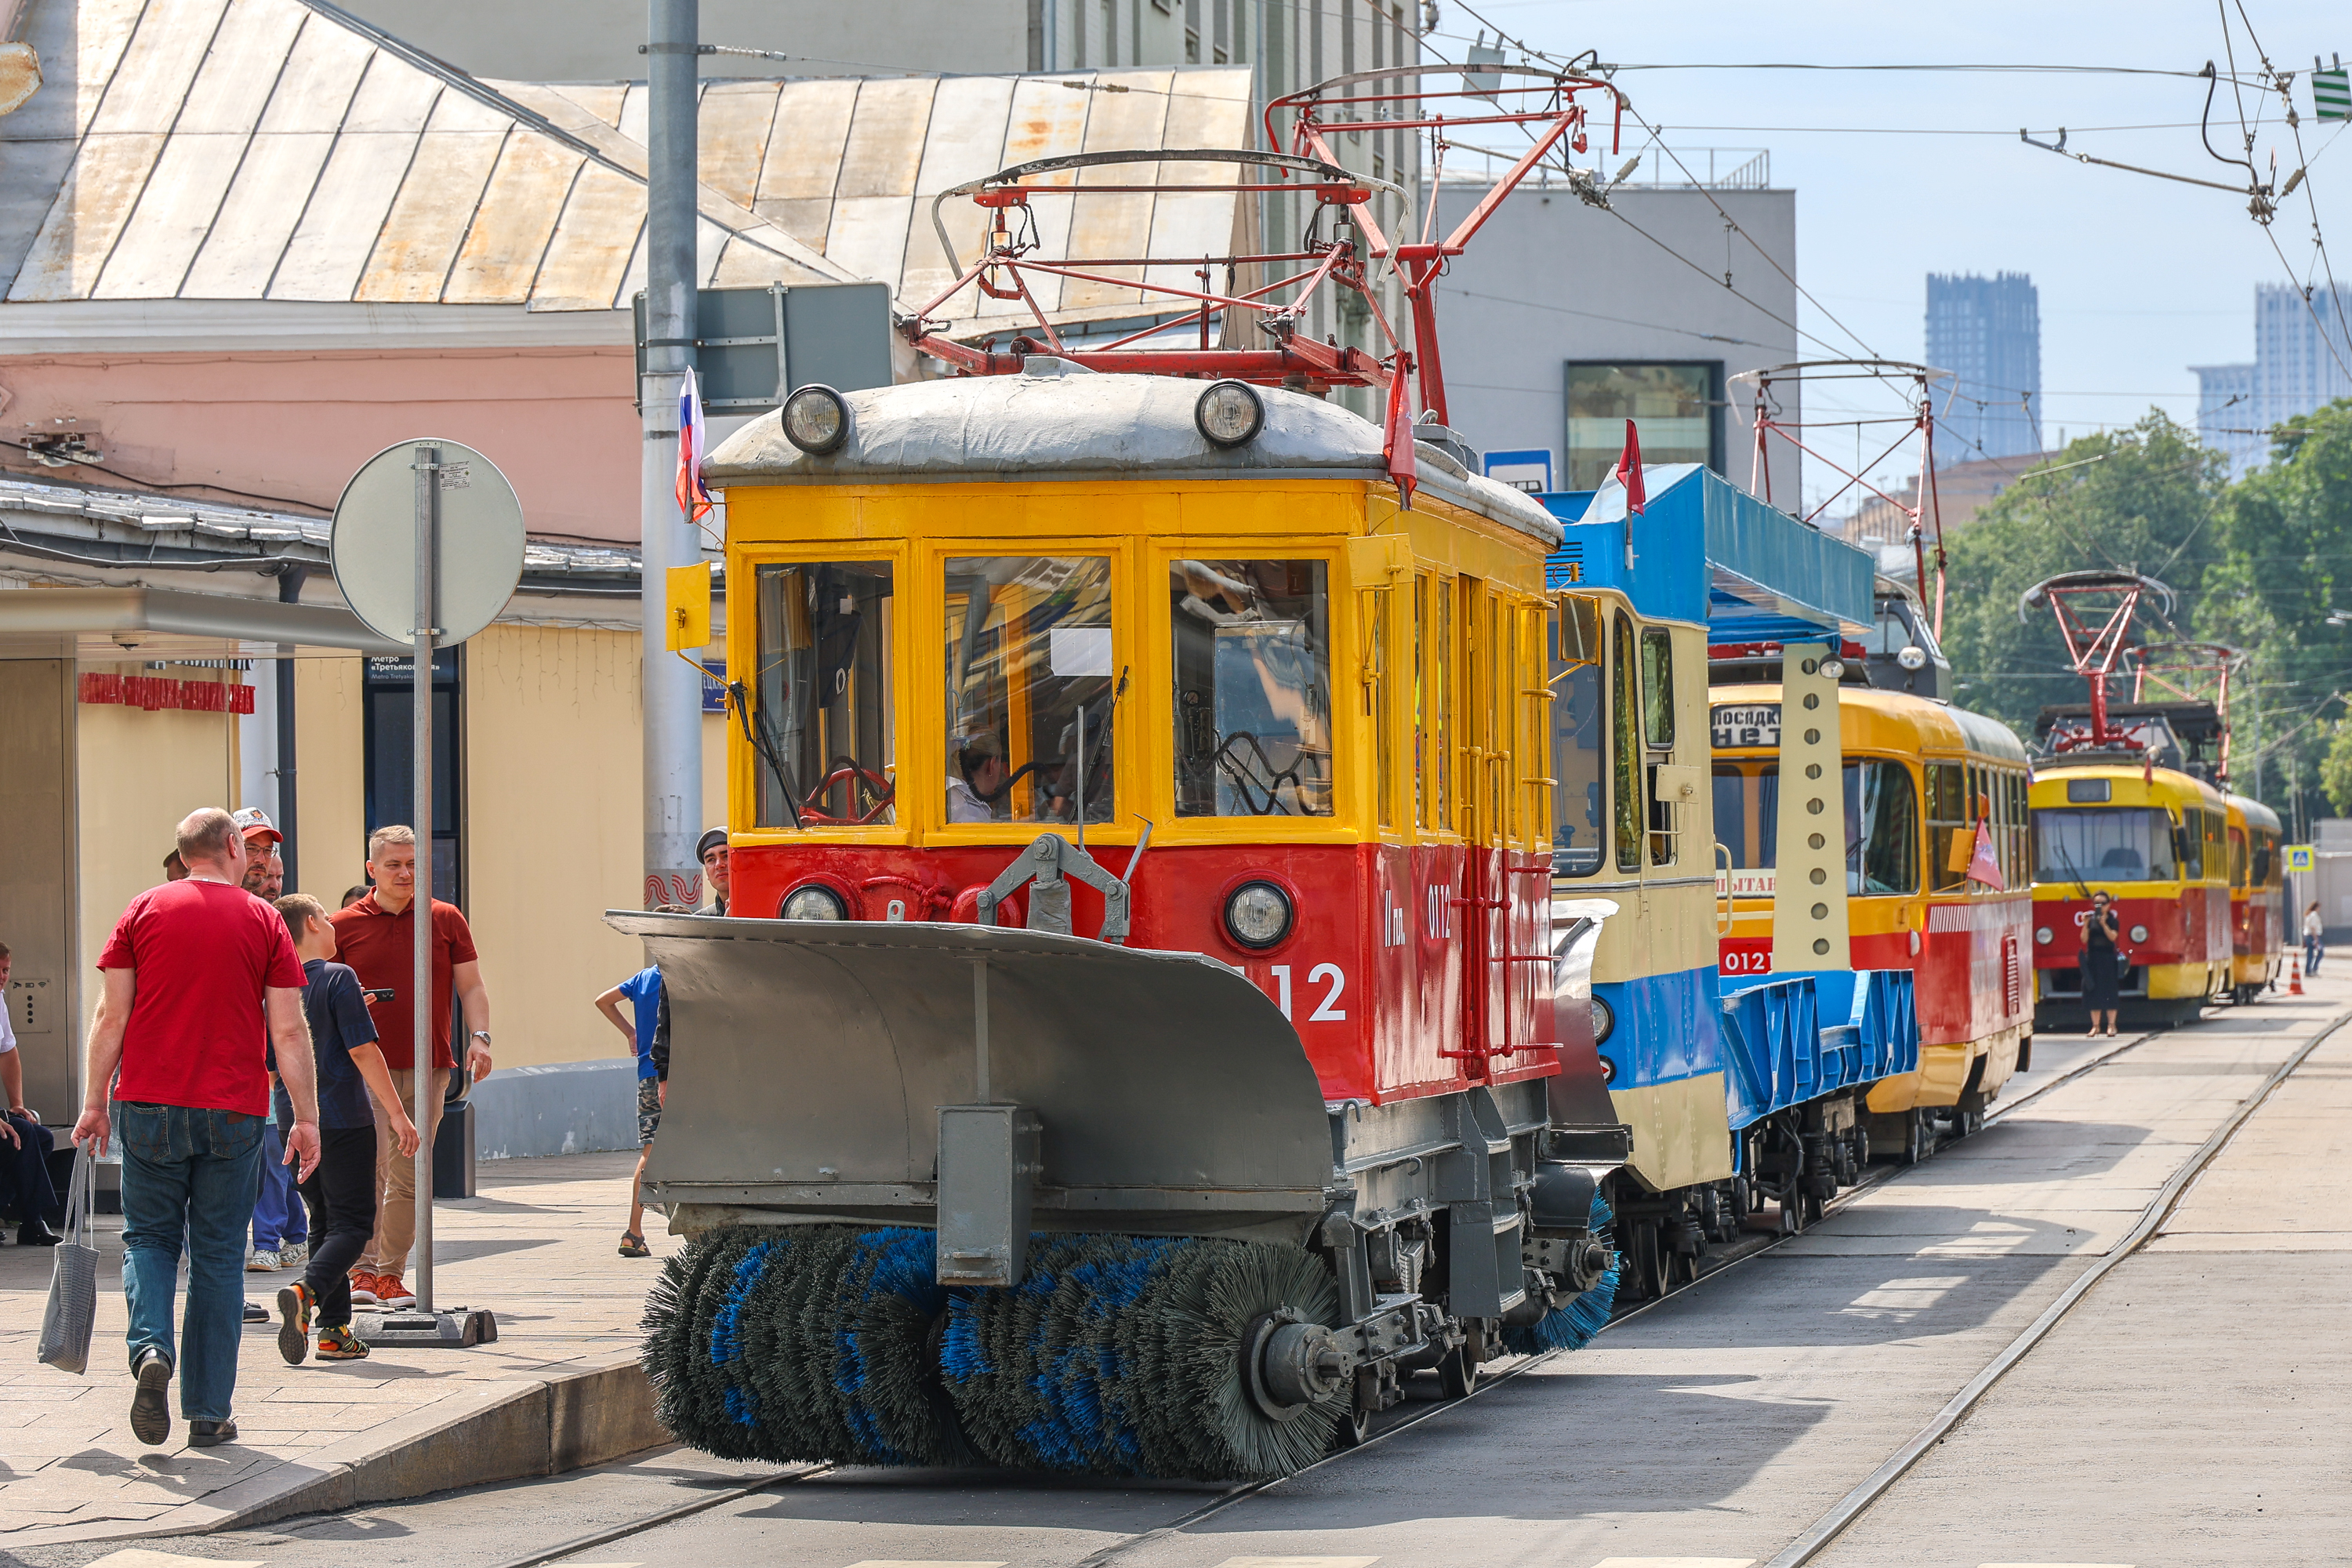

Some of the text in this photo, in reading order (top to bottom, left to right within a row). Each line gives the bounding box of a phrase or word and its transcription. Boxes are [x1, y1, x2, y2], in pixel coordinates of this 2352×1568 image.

[371, 663, 440, 672] «Третьякоя»
[1428, 884, 1450, 939] 0112
[1233, 963, 1346, 1022] 12
